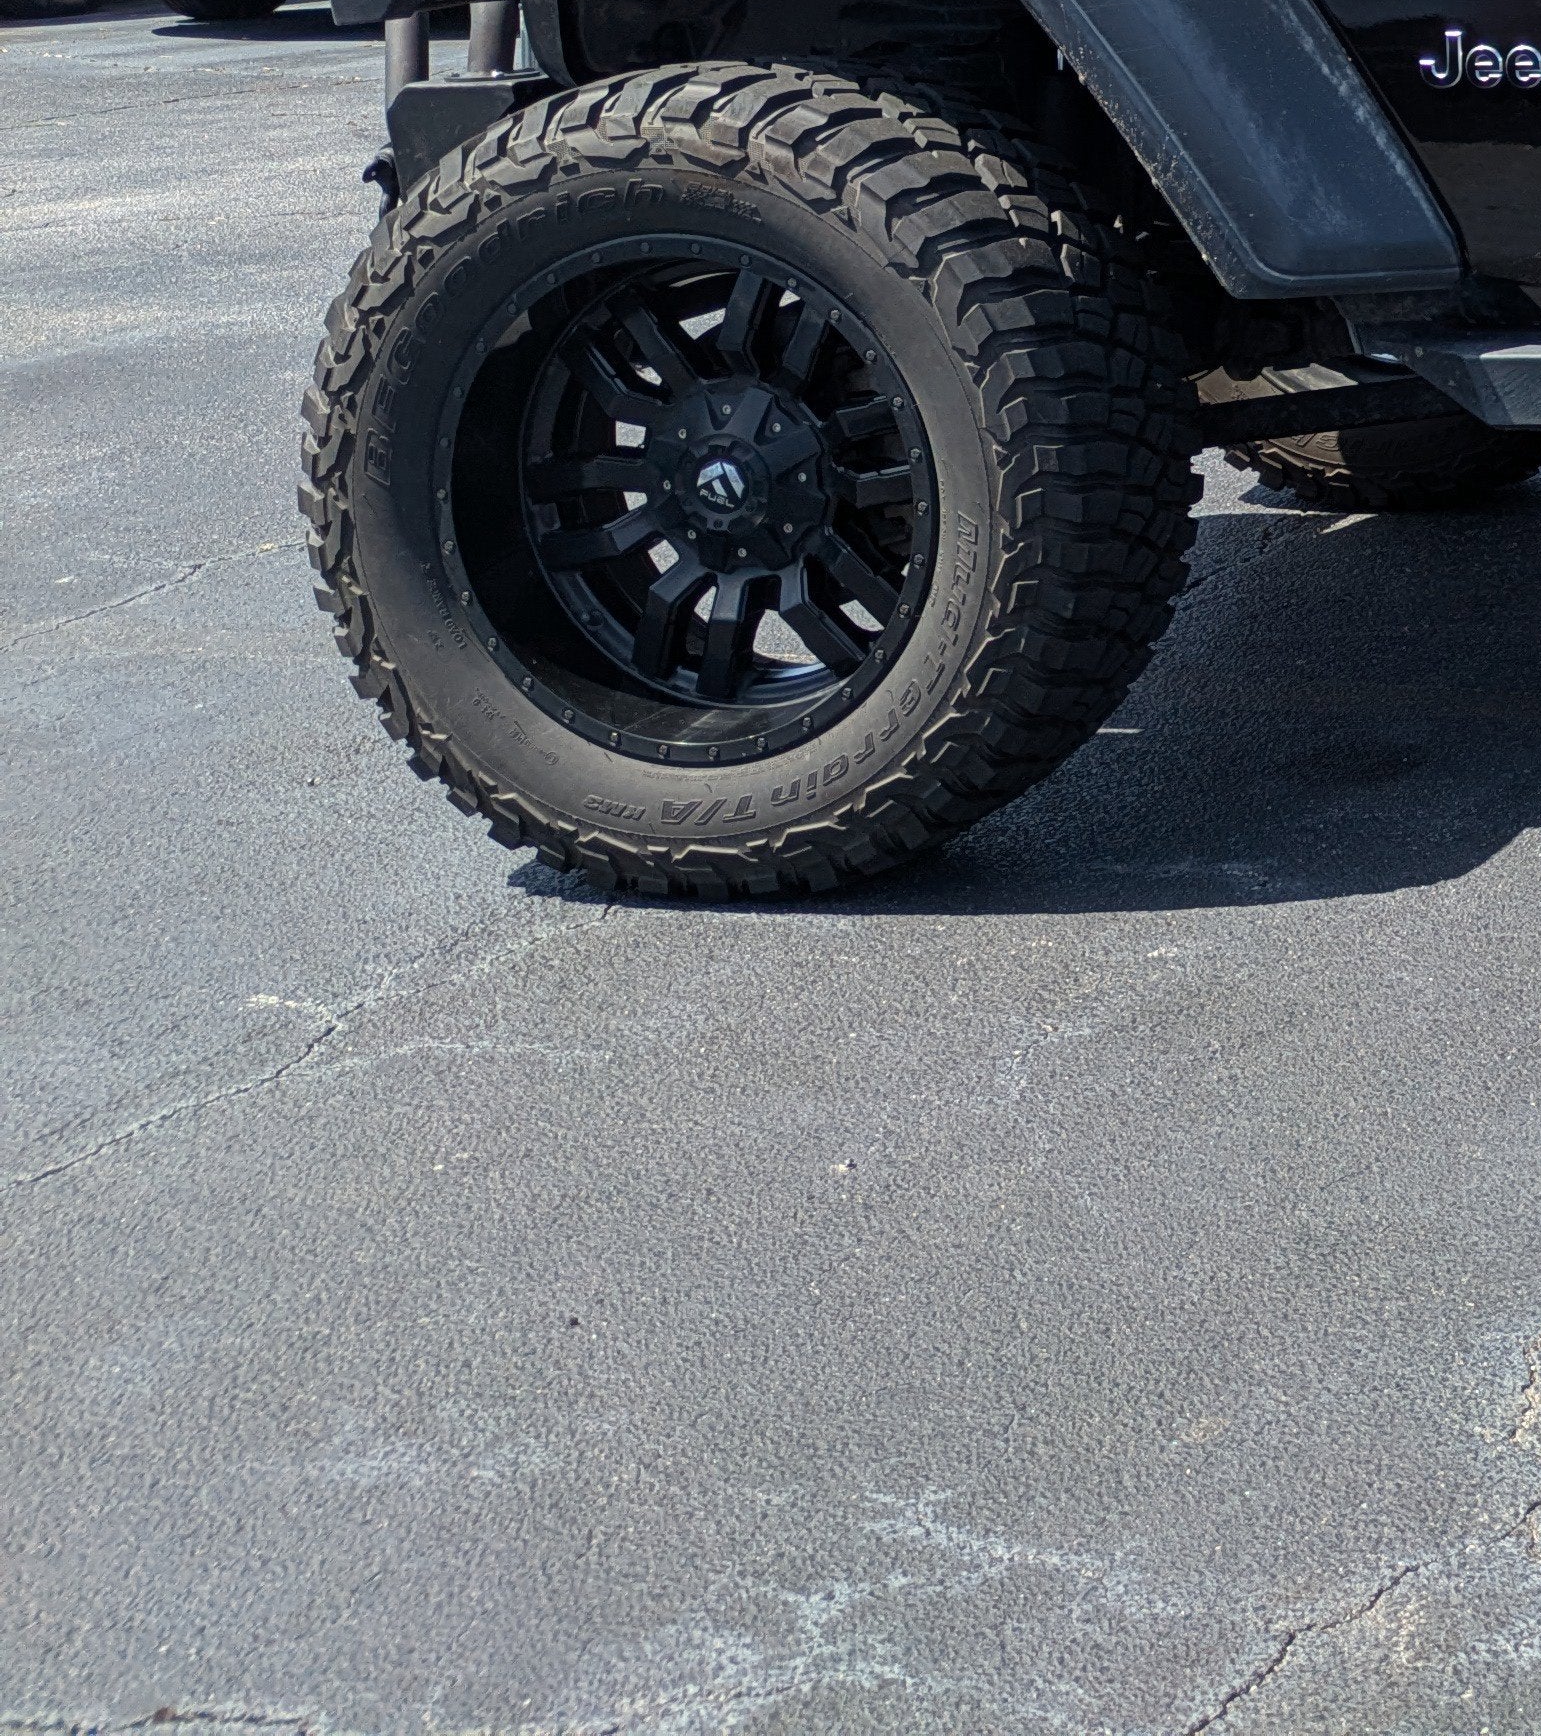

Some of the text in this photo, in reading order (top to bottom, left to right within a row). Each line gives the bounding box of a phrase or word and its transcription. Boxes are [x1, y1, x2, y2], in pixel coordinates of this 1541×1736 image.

[364, 177, 666, 487] BFGoodrich
[698, 488, 736, 509] FUEL
[770, 509, 981, 807] Mud-Terrain
[581, 792, 647, 822] KM3
[660, 797, 759, 827] T/A
